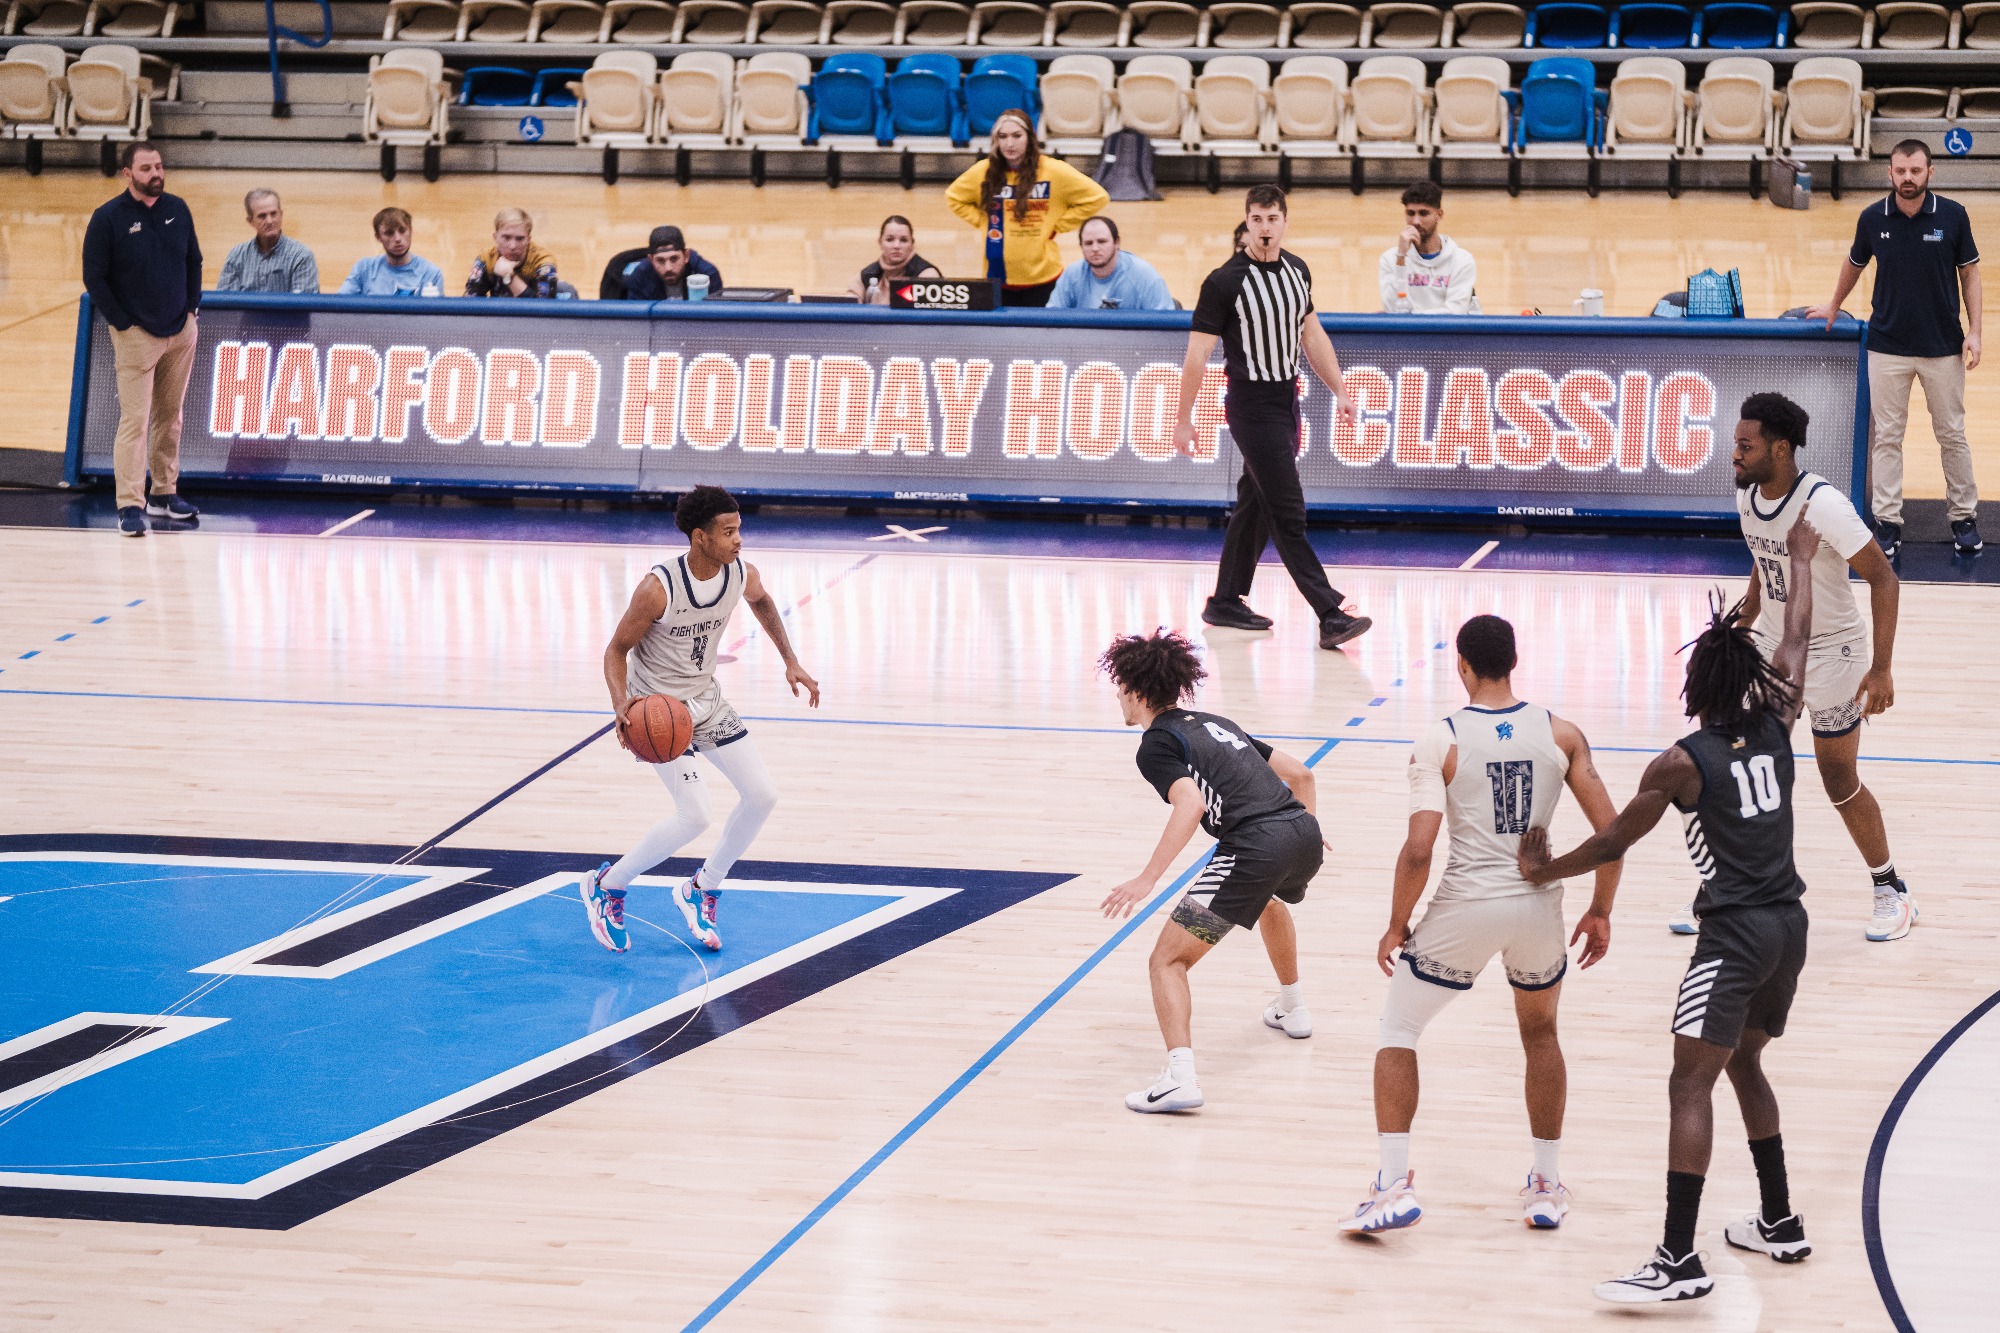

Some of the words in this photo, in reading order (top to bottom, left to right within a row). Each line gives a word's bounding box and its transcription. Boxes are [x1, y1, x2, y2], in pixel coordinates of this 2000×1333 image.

[912, 284, 970, 303] POSS
[209, 341, 601, 447] HARFORD
[618, 352, 993, 456] HOLIDAY
[1330, 366, 1717, 474] CLASSIC
[322, 474, 391, 484] DAKTRONICS
[893, 491, 968, 501] DAKTRONICS
[1497, 506, 1574, 516] DAKTRONICS
[1771, 540, 1789, 557] OWL
[1758, 556, 1788, 603] 13
[669, 620, 712, 637] FIGHTING
[690, 634, 709, 671] 4
[1202, 721, 1249, 750] 4
[1486, 760, 1533, 834] 10
[1730, 754, 1781, 818] 10
